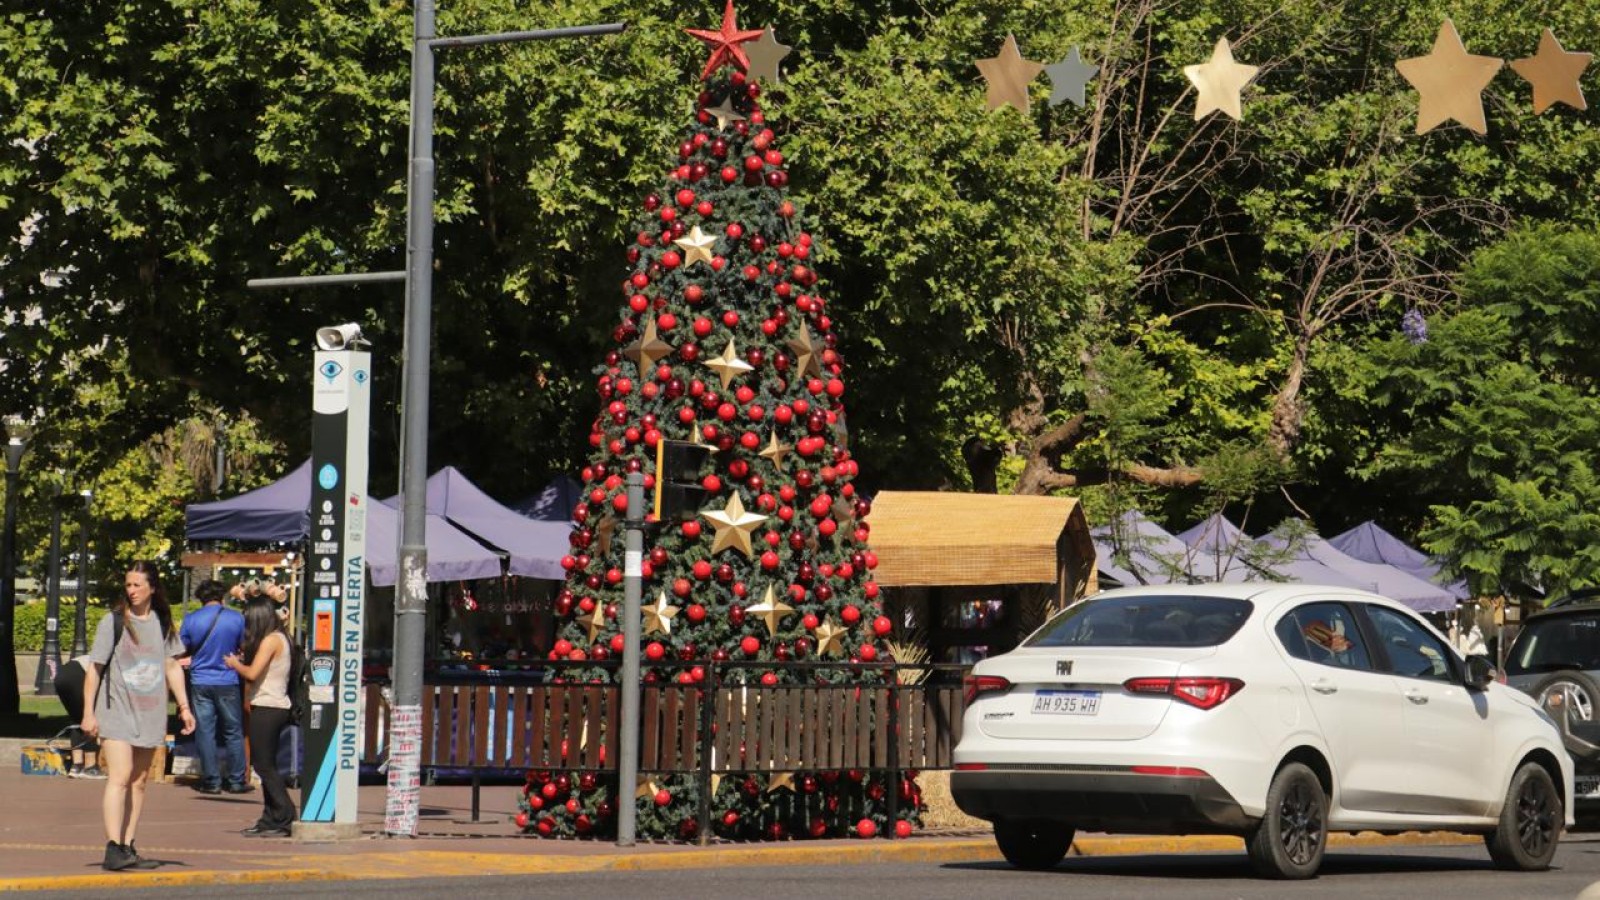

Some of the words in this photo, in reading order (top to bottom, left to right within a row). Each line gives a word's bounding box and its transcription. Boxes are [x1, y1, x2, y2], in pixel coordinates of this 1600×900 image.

[346, 555, 362, 625] ALERTA
[345, 631, 360, 653] EN
[343, 658, 359, 703] OJOS
[1034, 696, 1051, 711] AH
[1053, 697, 1077, 712] 935
[1080, 699, 1097, 712] WH
[341, 709, 357, 770] PUNTO
